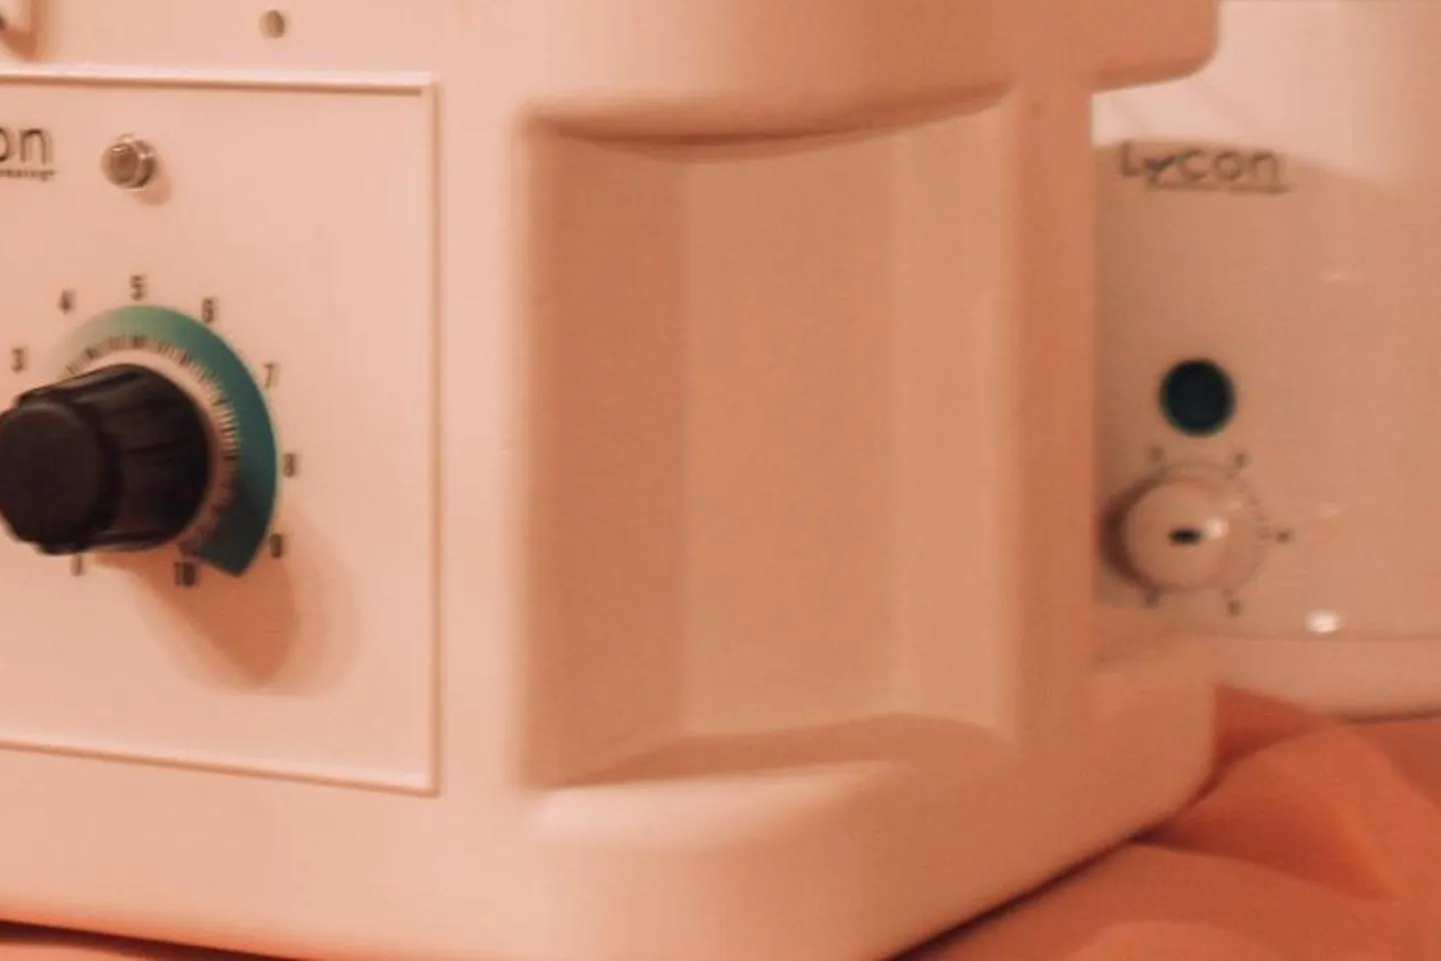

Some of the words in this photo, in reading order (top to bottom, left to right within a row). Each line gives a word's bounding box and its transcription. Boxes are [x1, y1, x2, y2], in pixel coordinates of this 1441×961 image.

[1120, 140, 1281, 190] Lycon
[130, 274, 145, 301] 5
[11, 346, 26, 373] 3
[263, 362, 278, 389] 7
[173, 560, 198, 587] 10
